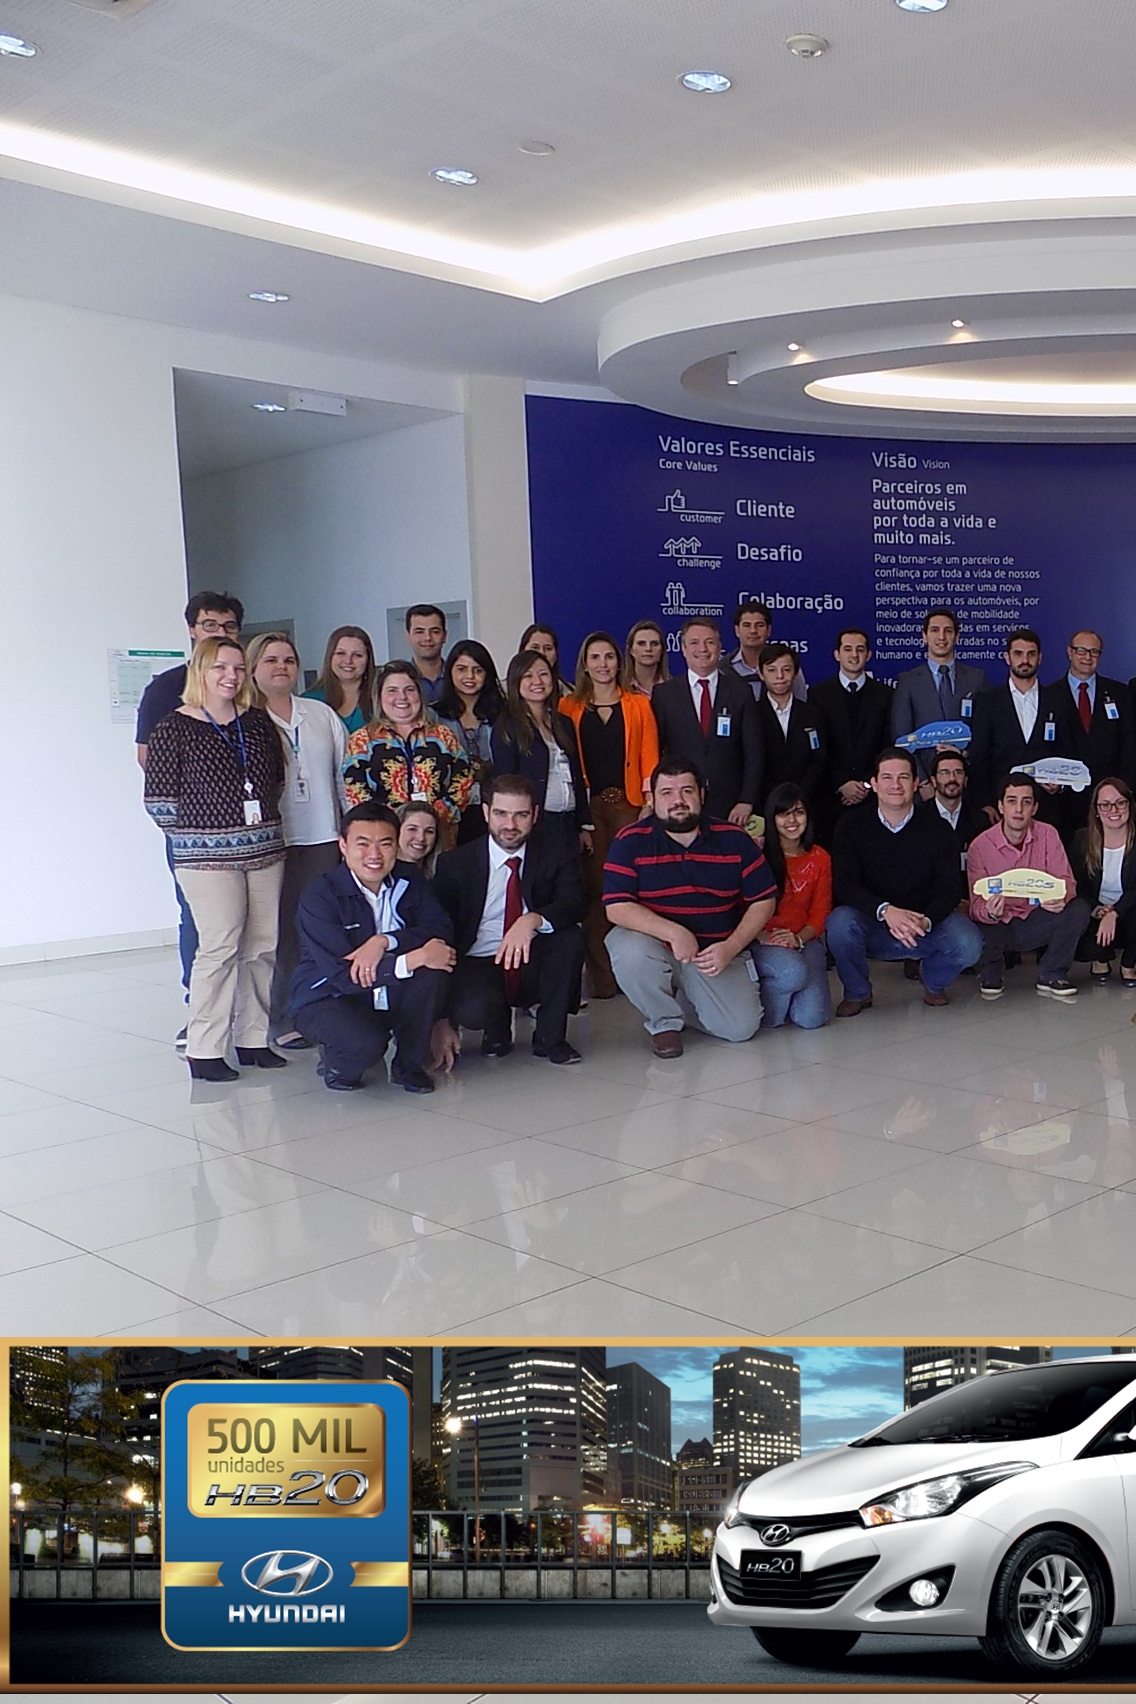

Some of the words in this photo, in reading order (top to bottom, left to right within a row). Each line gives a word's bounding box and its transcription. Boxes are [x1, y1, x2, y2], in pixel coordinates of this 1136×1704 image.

[658, 435, 724, 456] Valores
[729, 440, 816, 462] Essenciais
[659, 458, 683, 470] Core
[685, 460, 719, 473] Values
[872, 452, 917, 469] Visão
[922, 459, 950, 469] Vision
[872, 479, 942, 494] Parceiros
[946, 483, 967, 495] em
[736, 499, 795, 518] Cliente
[873, 497, 956, 511] automóveis
[680, 513, 723, 523] customer
[873, 515, 898, 530] por
[903, 514, 935, 528] toda
[940, 517, 949, 528] a
[953, 514, 983, 528] vida
[988, 518, 997, 528] e
[874, 530, 914, 544] muito
[919, 531, 956, 545] mais.
[737, 543, 803, 562] Desafio
[677, 558, 722, 570] challenge
[874, 553, 896, 564] Para
[898, 554, 943, 565] tornar-se
[945, 556, 960, 565] um
[962, 555, 1000, 566] parceiro
[1002, 555, 1015, 565] de
[874, 567, 920, 579] confiança
[922, 569, 938, 579] por
[941, 568, 962, 578] toda
[964, 570, 971, 578] a
[972, 568, 992, 578] vida
[994, 569, 1006, 579] de
[1008, 570, 1041, 579] nossos
[875, 581, 913, 592] clientes,
[915, 583, 945, 592] vamos
[947, 582, 975, 592] trazer
[977, 583, 997, 592] uma
[999, 584, 1022, 592] nova
[875, 595, 928, 607] perspectiva
[930, 597, 951, 607] para
[953, 597, 965, 605] os
[967, 596, 1021, 606] automóveis,
[1023, 598, 1040, 607] por
[662, 606, 723, 616] collaboration
[875, 608, 898, 619] meio
[900, 609, 913, 619] de
[957, 609, 969, 619] de
[971, 609, 1020, 619] mobilidade
[976, 624, 990, 632] em
[876, 638, 883, 646] e
[885, 636, 925, 648] tecnolog
[987, 638, 1000, 646] no
[875, 650, 913, 660] humano
[915, 652, 922, 660] e
